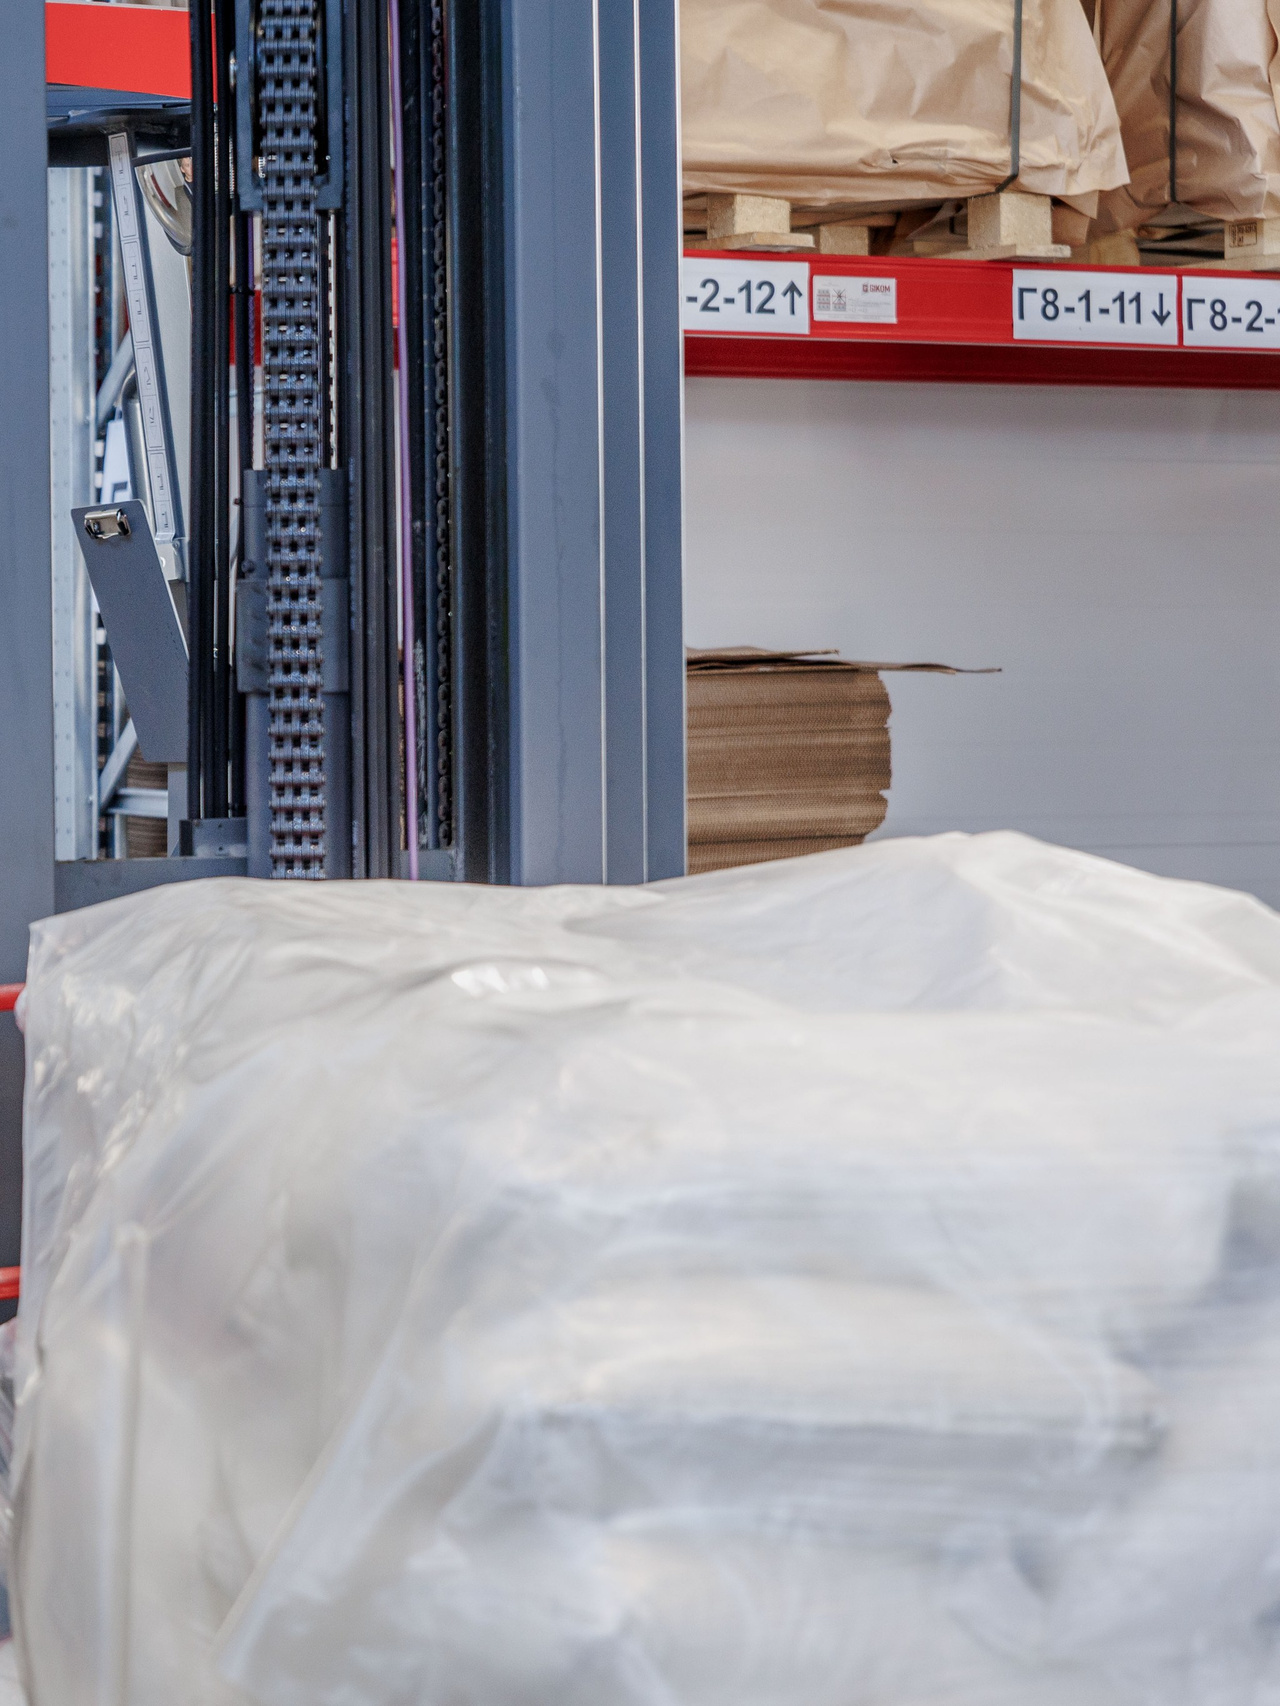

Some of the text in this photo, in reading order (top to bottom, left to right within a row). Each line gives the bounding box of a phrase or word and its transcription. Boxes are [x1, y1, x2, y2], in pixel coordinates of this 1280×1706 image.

[869, 284, 891, 293] GIKOM
[1018, 287, 1141, 324] Г8-1-11
[1187, 298, 1280, 332] Г8-2-
